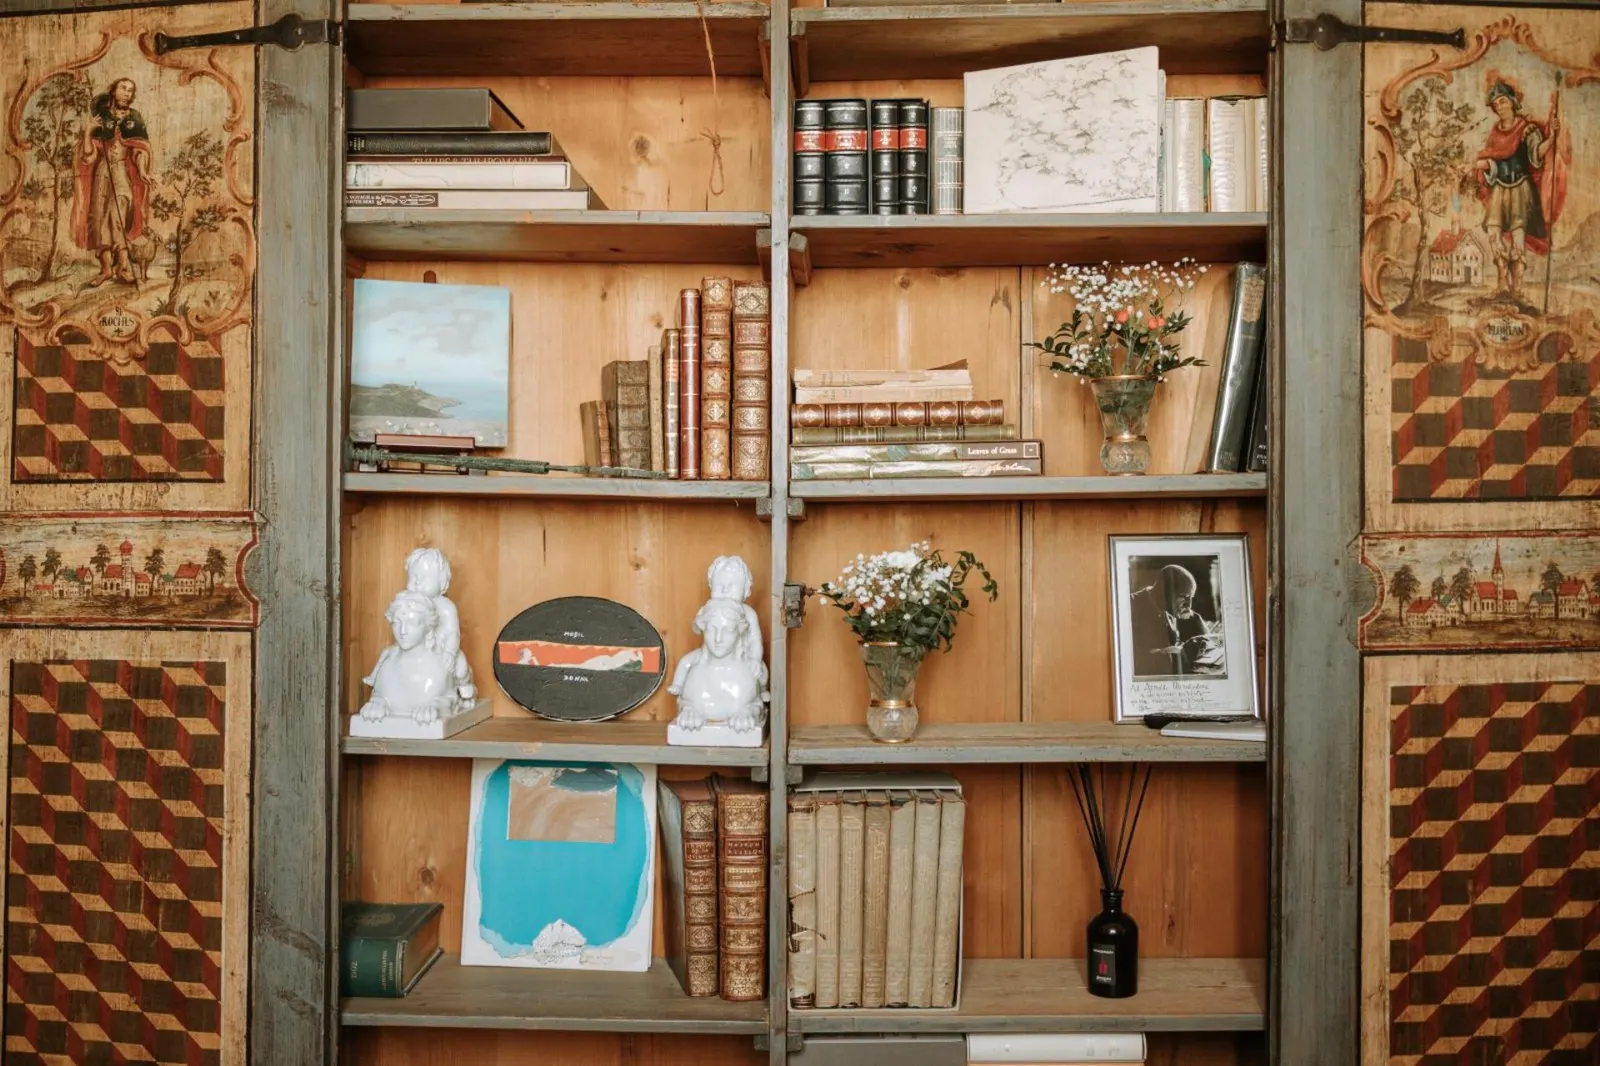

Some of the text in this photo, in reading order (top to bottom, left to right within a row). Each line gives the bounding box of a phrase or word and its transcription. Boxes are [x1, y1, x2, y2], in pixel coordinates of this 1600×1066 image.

[968, 446, 1017, 455] Leaves of Grass
